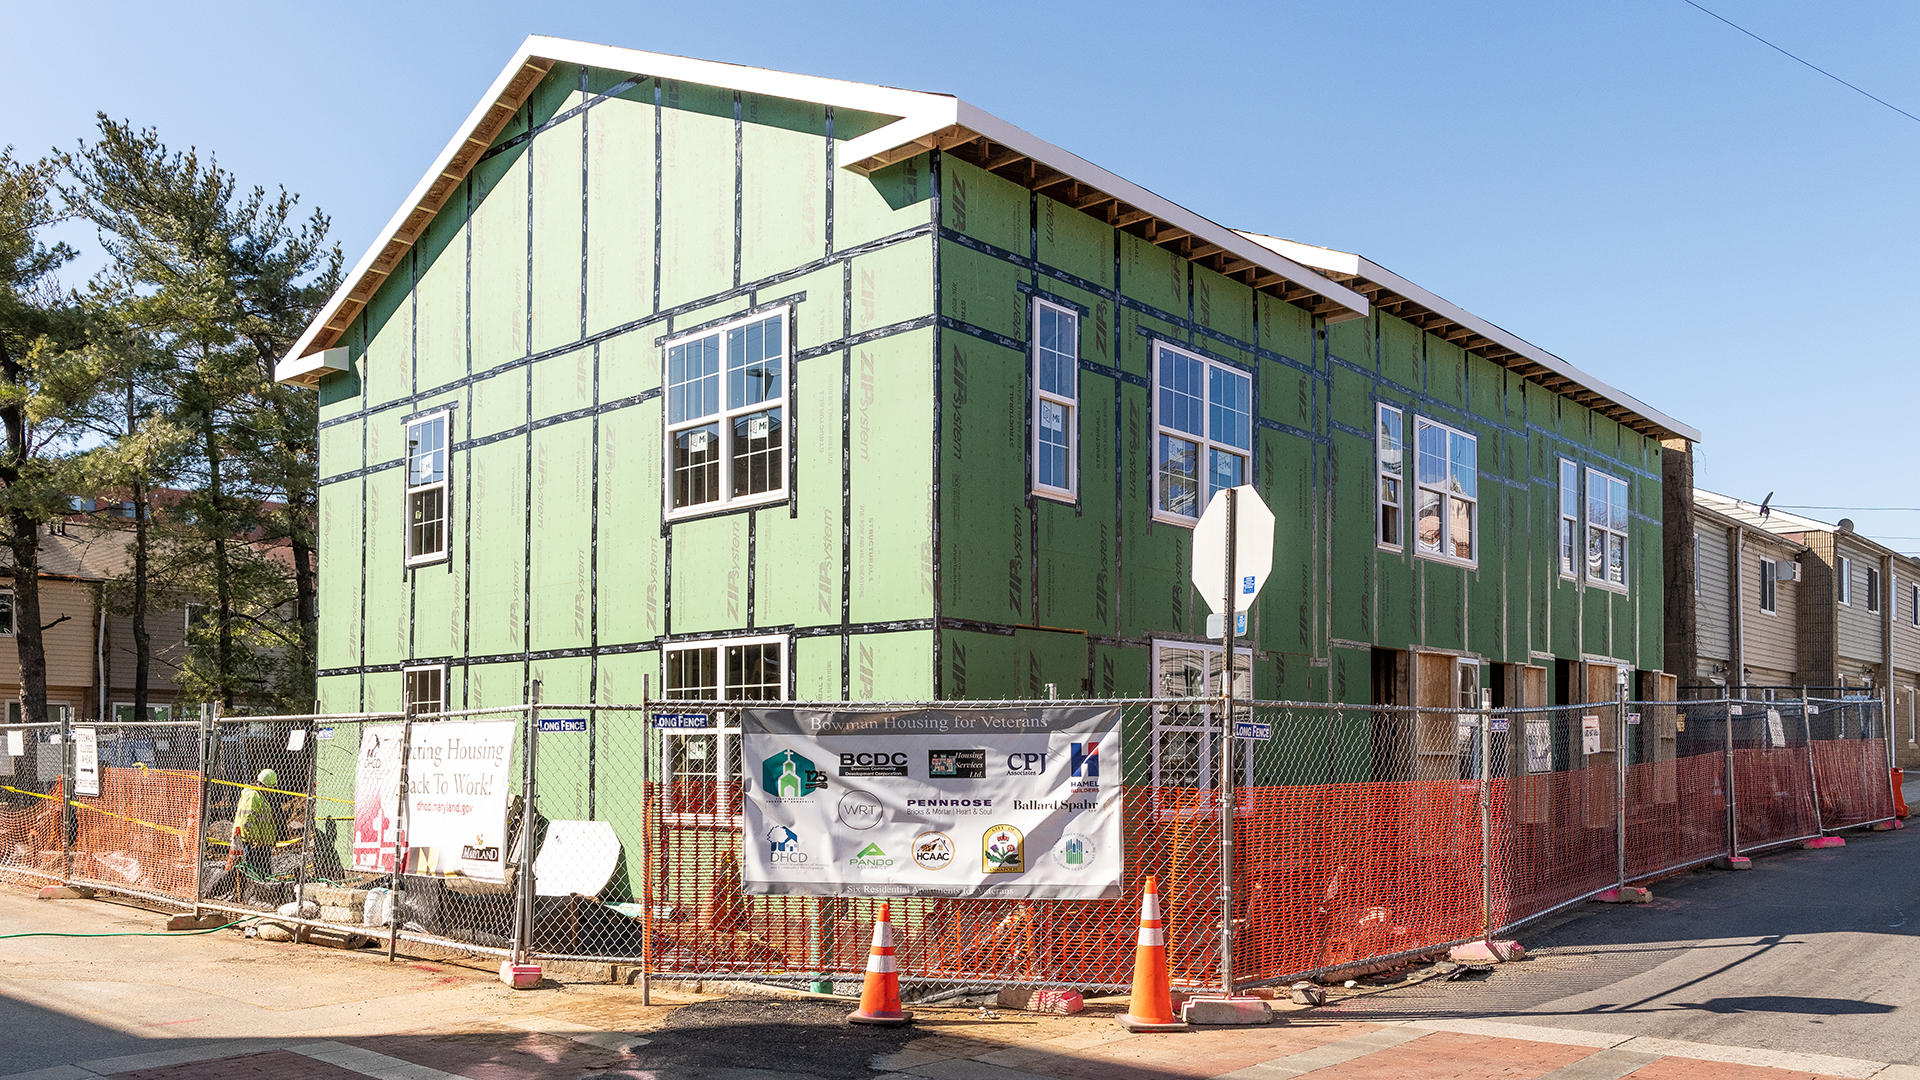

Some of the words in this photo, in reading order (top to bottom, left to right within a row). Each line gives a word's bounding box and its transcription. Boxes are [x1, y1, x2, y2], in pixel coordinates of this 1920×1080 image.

[539, 720, 560, 730] LONG
[560, 719, 585, 730] FENCE
[654, 716, 677, 727] LONG
[678, 715, 706, 727] FENCE
[810, 716, 879, 731] Bowman
[883, 715, 950, 732] Housing
[954, 715, 977, 729] for
[981, 716, 1048, 728] Veterans
[1236, 724, 1252, 737] LONG
[1252, 725, 1270, 738] FENCE
[447, 738, 504, 767] Housing
[955, 751, 984, 760] Housing
[840, 752, 908, 766] BCDC
[955, 761, 984, 769] Services
[1007, 753, 1047, 775] CPJ
[805, 770, 828, 782] 125
[405, 773, 430, 794] Back
[433, 773, 449, 795] To
[454, 773, 493, 796] Work!
[416, 801, 474, 816] dhcd.maryland.gov
[907, 799, 992, 807] PENNROSE
[1013, 799, 1058, 811] Ballard
[1061, 799, 1098, 812] Spahr
[844, 805, 877, 815] WRT
[462, 847, 498, 861] MARYLAND
[770, 852, 808, 863] DHCD
[917, 852, 950, 861] HCAAC
[847, 884, 860, 893] Six
[863, 884, 910, 894] Residential
[912, 886, 960, 896] Apartments
[979, 887, 1014, 895] Veterans
